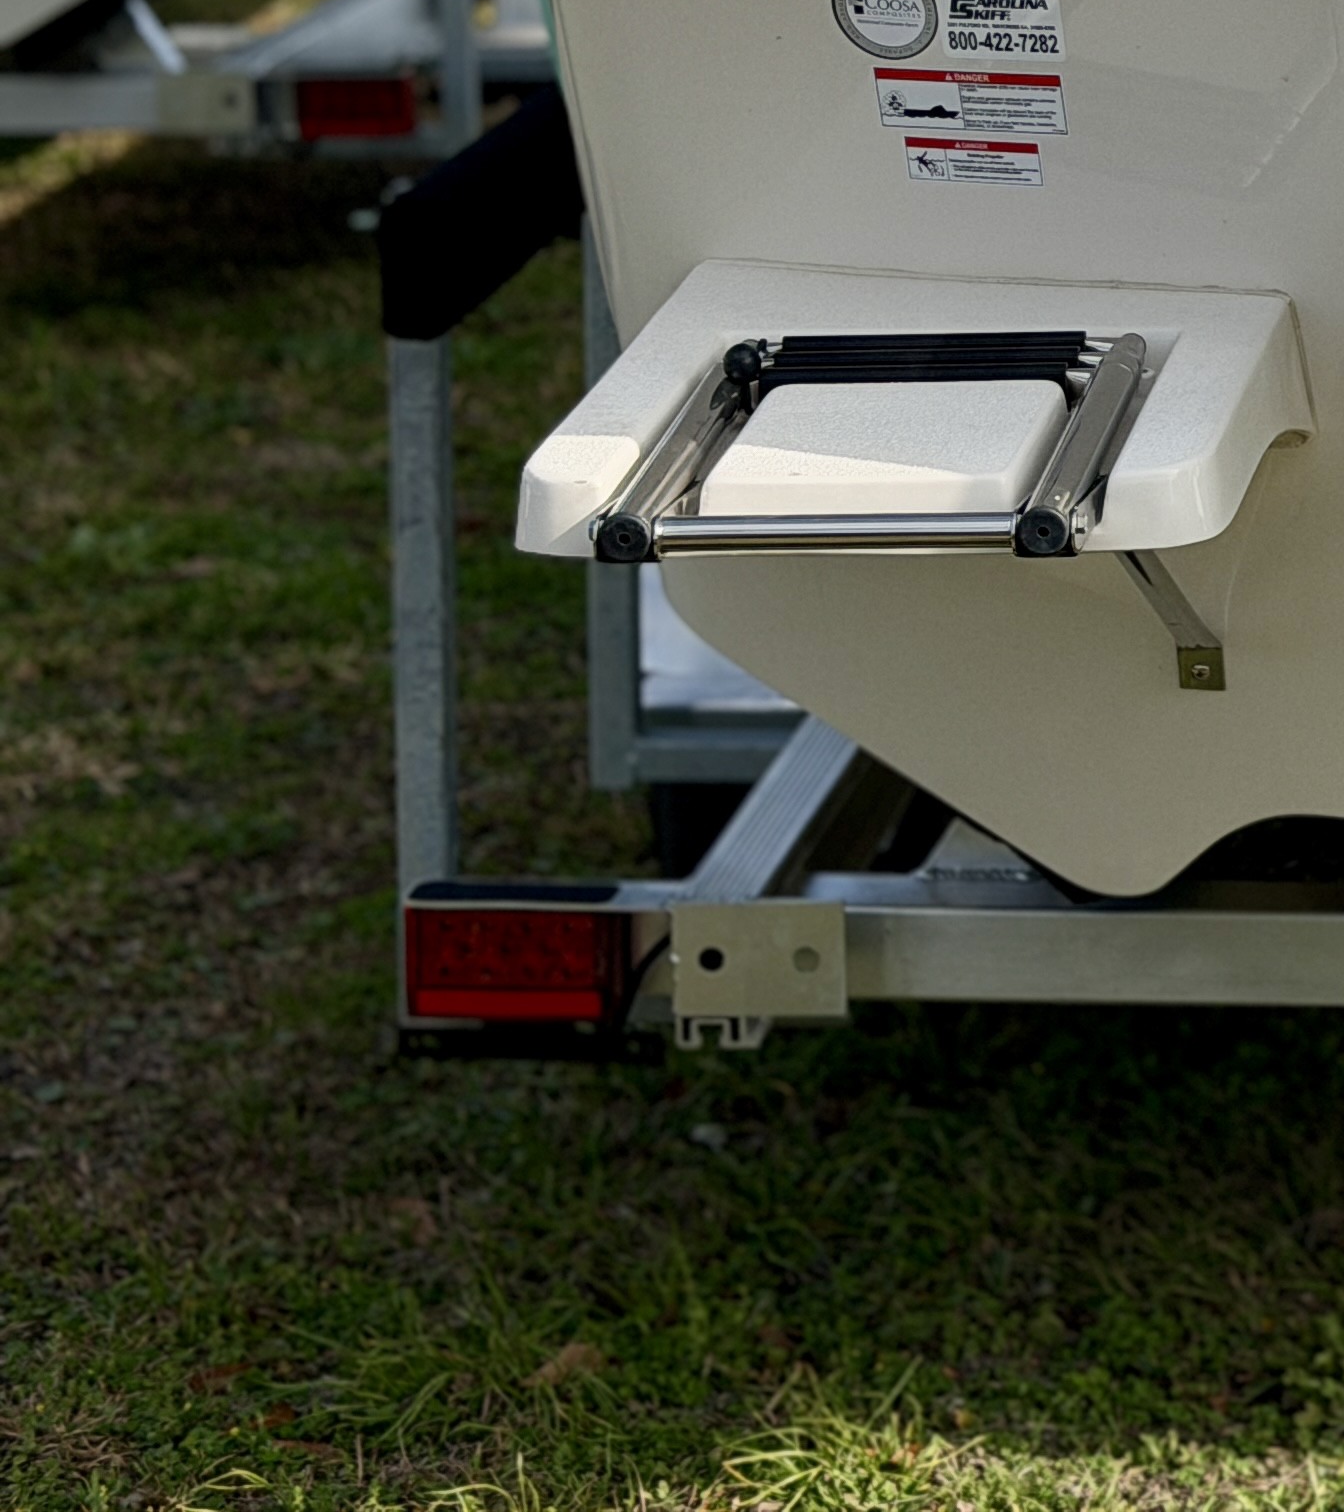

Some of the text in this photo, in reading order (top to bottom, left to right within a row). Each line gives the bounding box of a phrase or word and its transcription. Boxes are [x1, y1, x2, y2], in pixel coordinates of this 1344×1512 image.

[866, 9, 921, 19] COMPOSITES
[949, 3, 1011, 21] SKIFF
[948, 31, 1060, 54] 800-422-7282
[953, 72, 991, 83] DANGER
